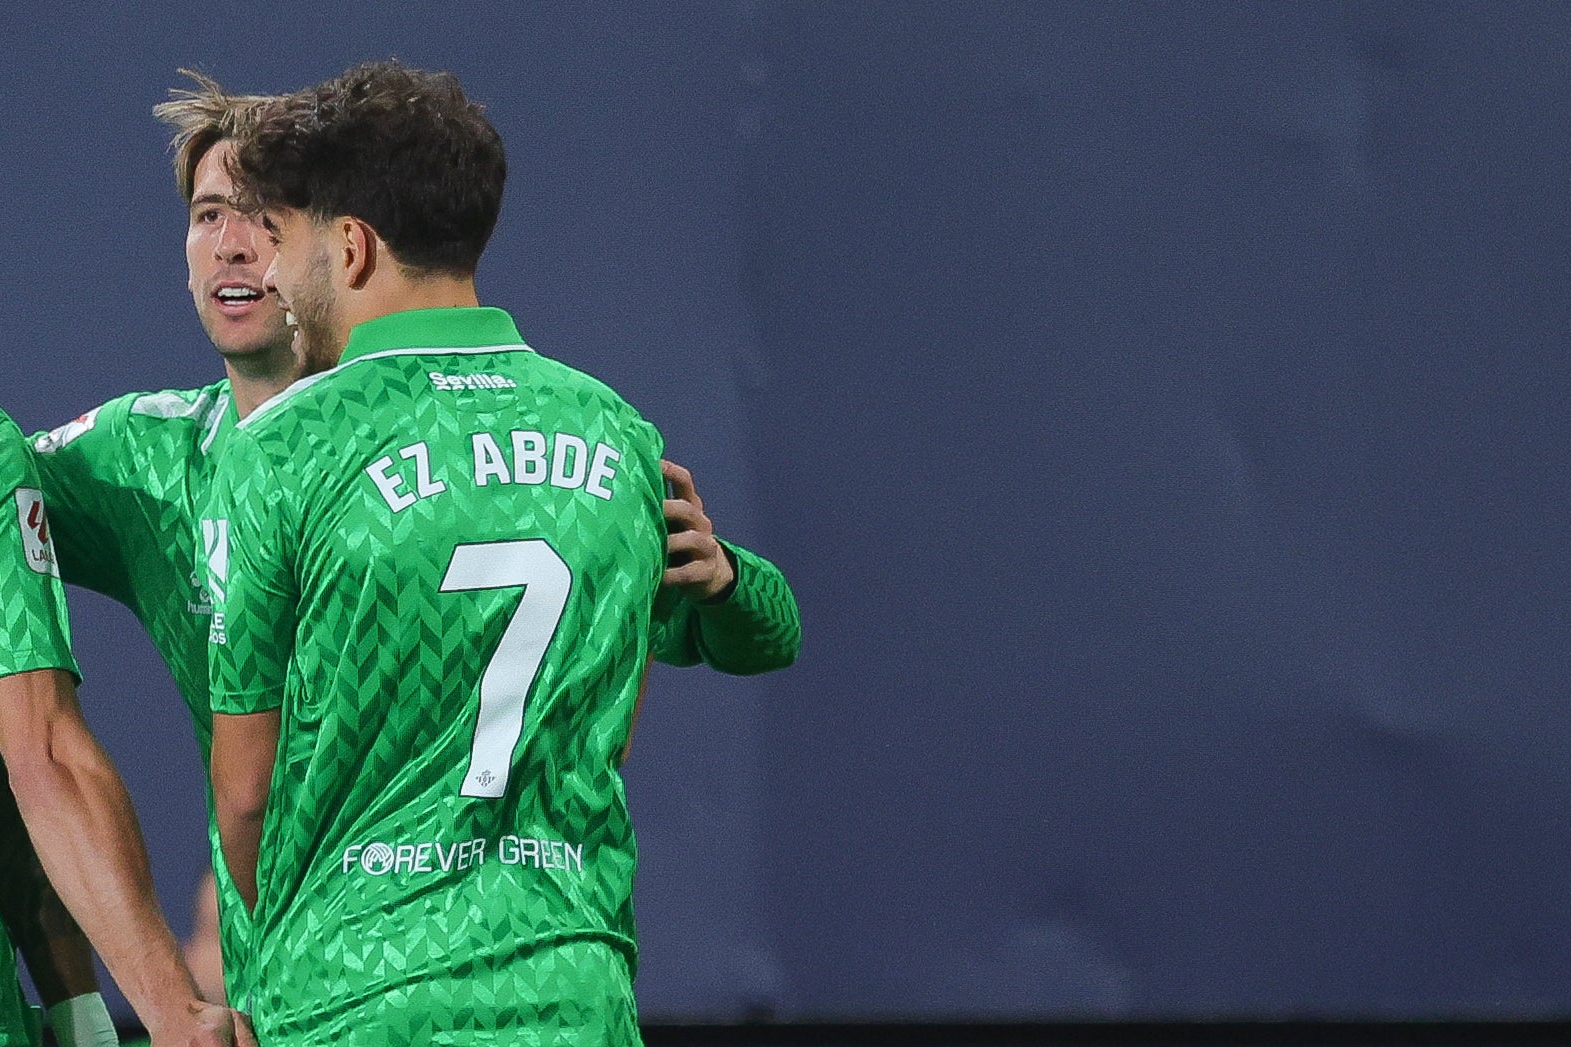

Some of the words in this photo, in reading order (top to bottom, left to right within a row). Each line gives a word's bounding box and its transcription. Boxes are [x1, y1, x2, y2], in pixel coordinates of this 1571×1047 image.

[366, 441, 444, 514] EZ
[471, 430, 620, 500] ABDE
[438, 538, 573, 800] 7
[342, 837, 487, 876] FOREVER
[498, 834, 584, 873] GREEN
